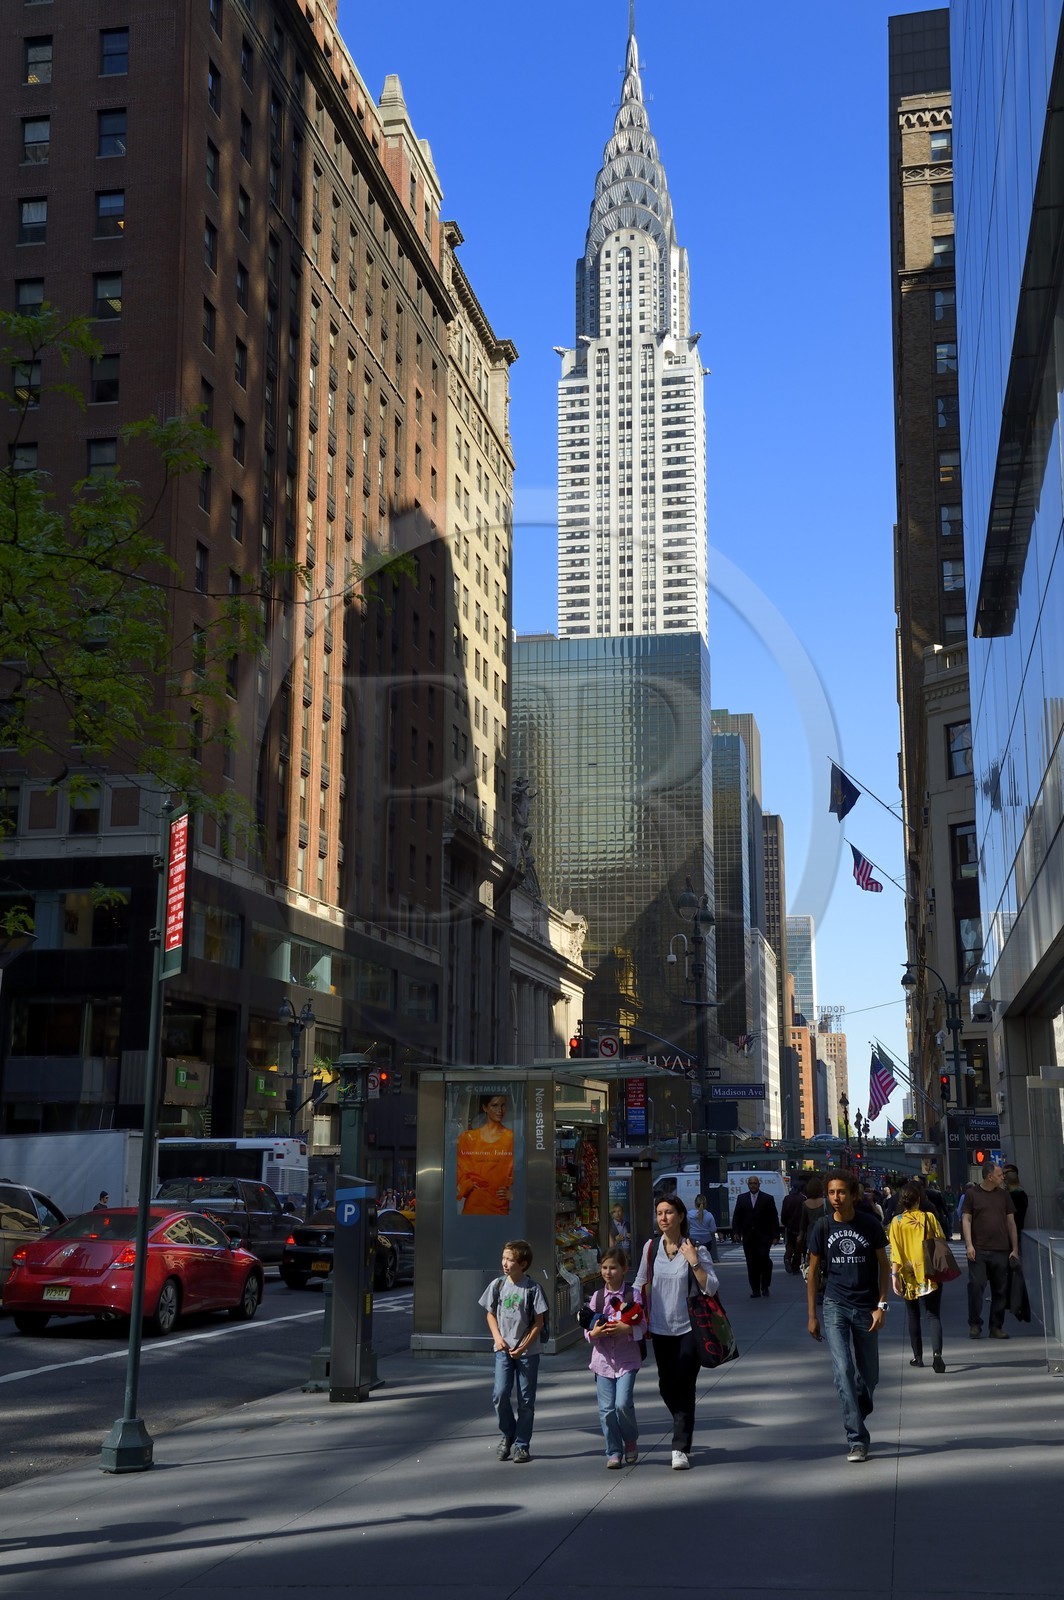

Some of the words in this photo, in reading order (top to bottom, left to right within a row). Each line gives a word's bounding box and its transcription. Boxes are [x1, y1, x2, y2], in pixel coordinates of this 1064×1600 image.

[816, 1005, 846, 1013] TUDOR
[713, 1088, 746, 1096] Madison
[749, 1088, 763, 1096] Ave
[535, 1088, 545, 1150] Newsstand
[344, 1203, 356, 1223] P
[831, 1256, 845, 1264] AND
[846, 1255, 866, 1264] FITCH
